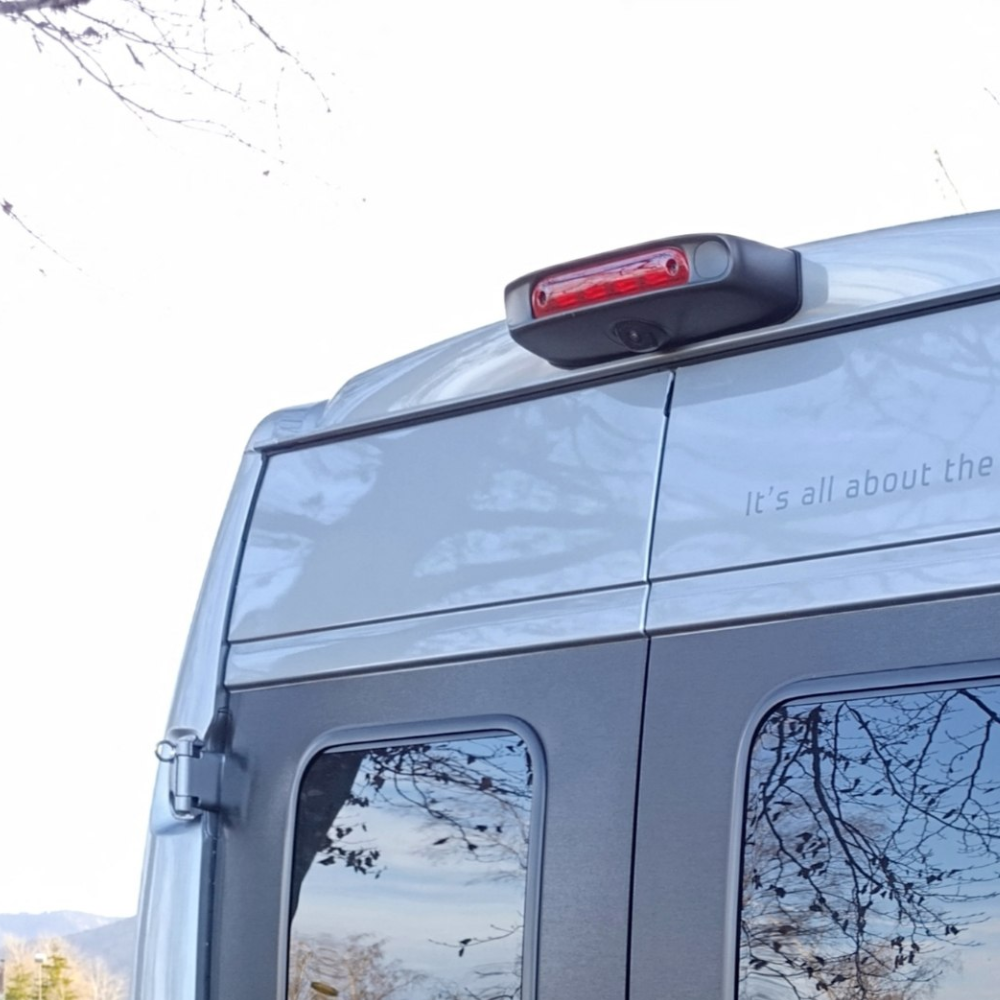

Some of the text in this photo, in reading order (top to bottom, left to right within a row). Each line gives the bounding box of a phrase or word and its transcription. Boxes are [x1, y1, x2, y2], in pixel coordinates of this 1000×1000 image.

[745, 486, 789, 516] It's
[800, 476, 834, 506] all
[845, 462, 932, 499] about
[944, 453, 994, 483] the
